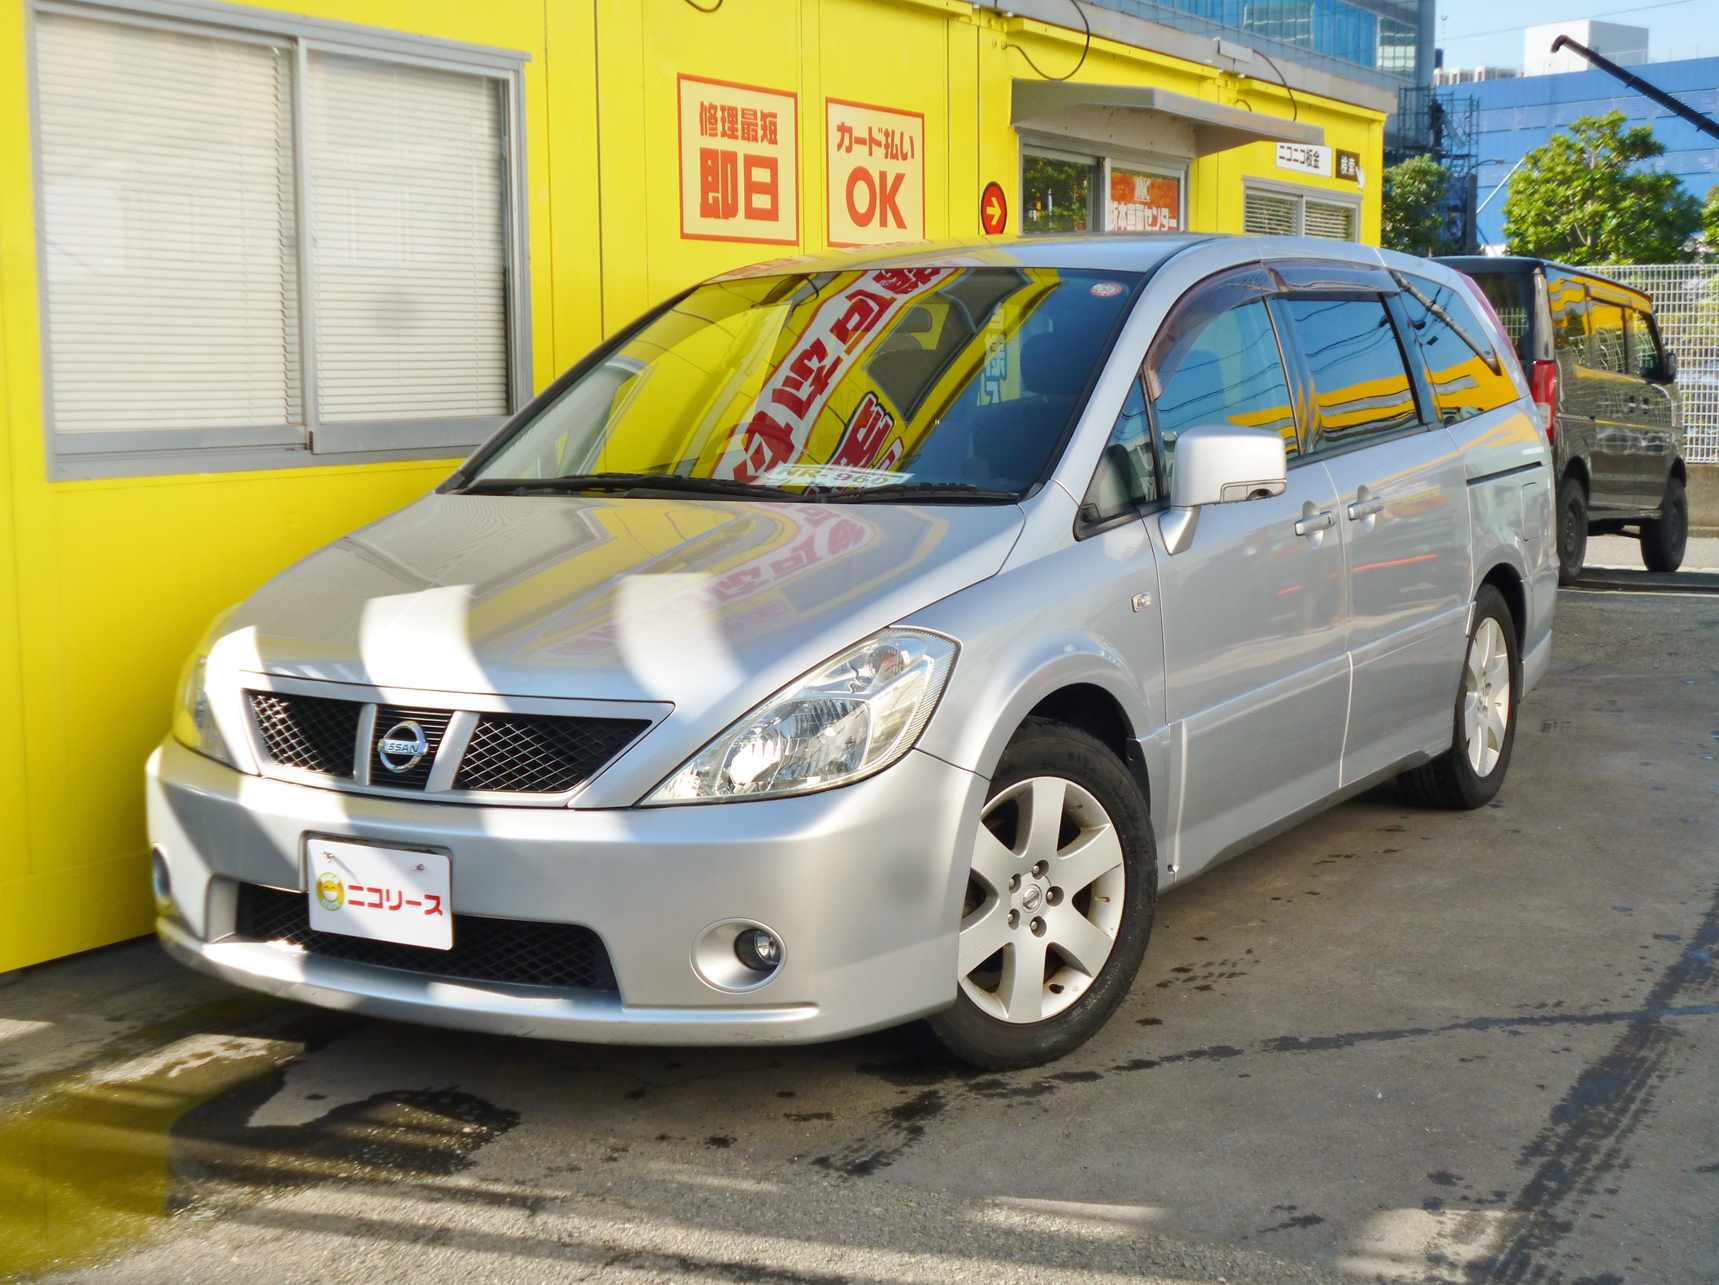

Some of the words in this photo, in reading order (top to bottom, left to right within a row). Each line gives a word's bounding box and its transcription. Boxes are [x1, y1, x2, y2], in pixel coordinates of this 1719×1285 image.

[699, 100, 779, 145] 修理最短
[836, 121, 915, 161] カード払い
[699, 147, 780, 222] 即日
[845, 165, 908, 230] OK
[348, 884, 443, 916] ニコリース
